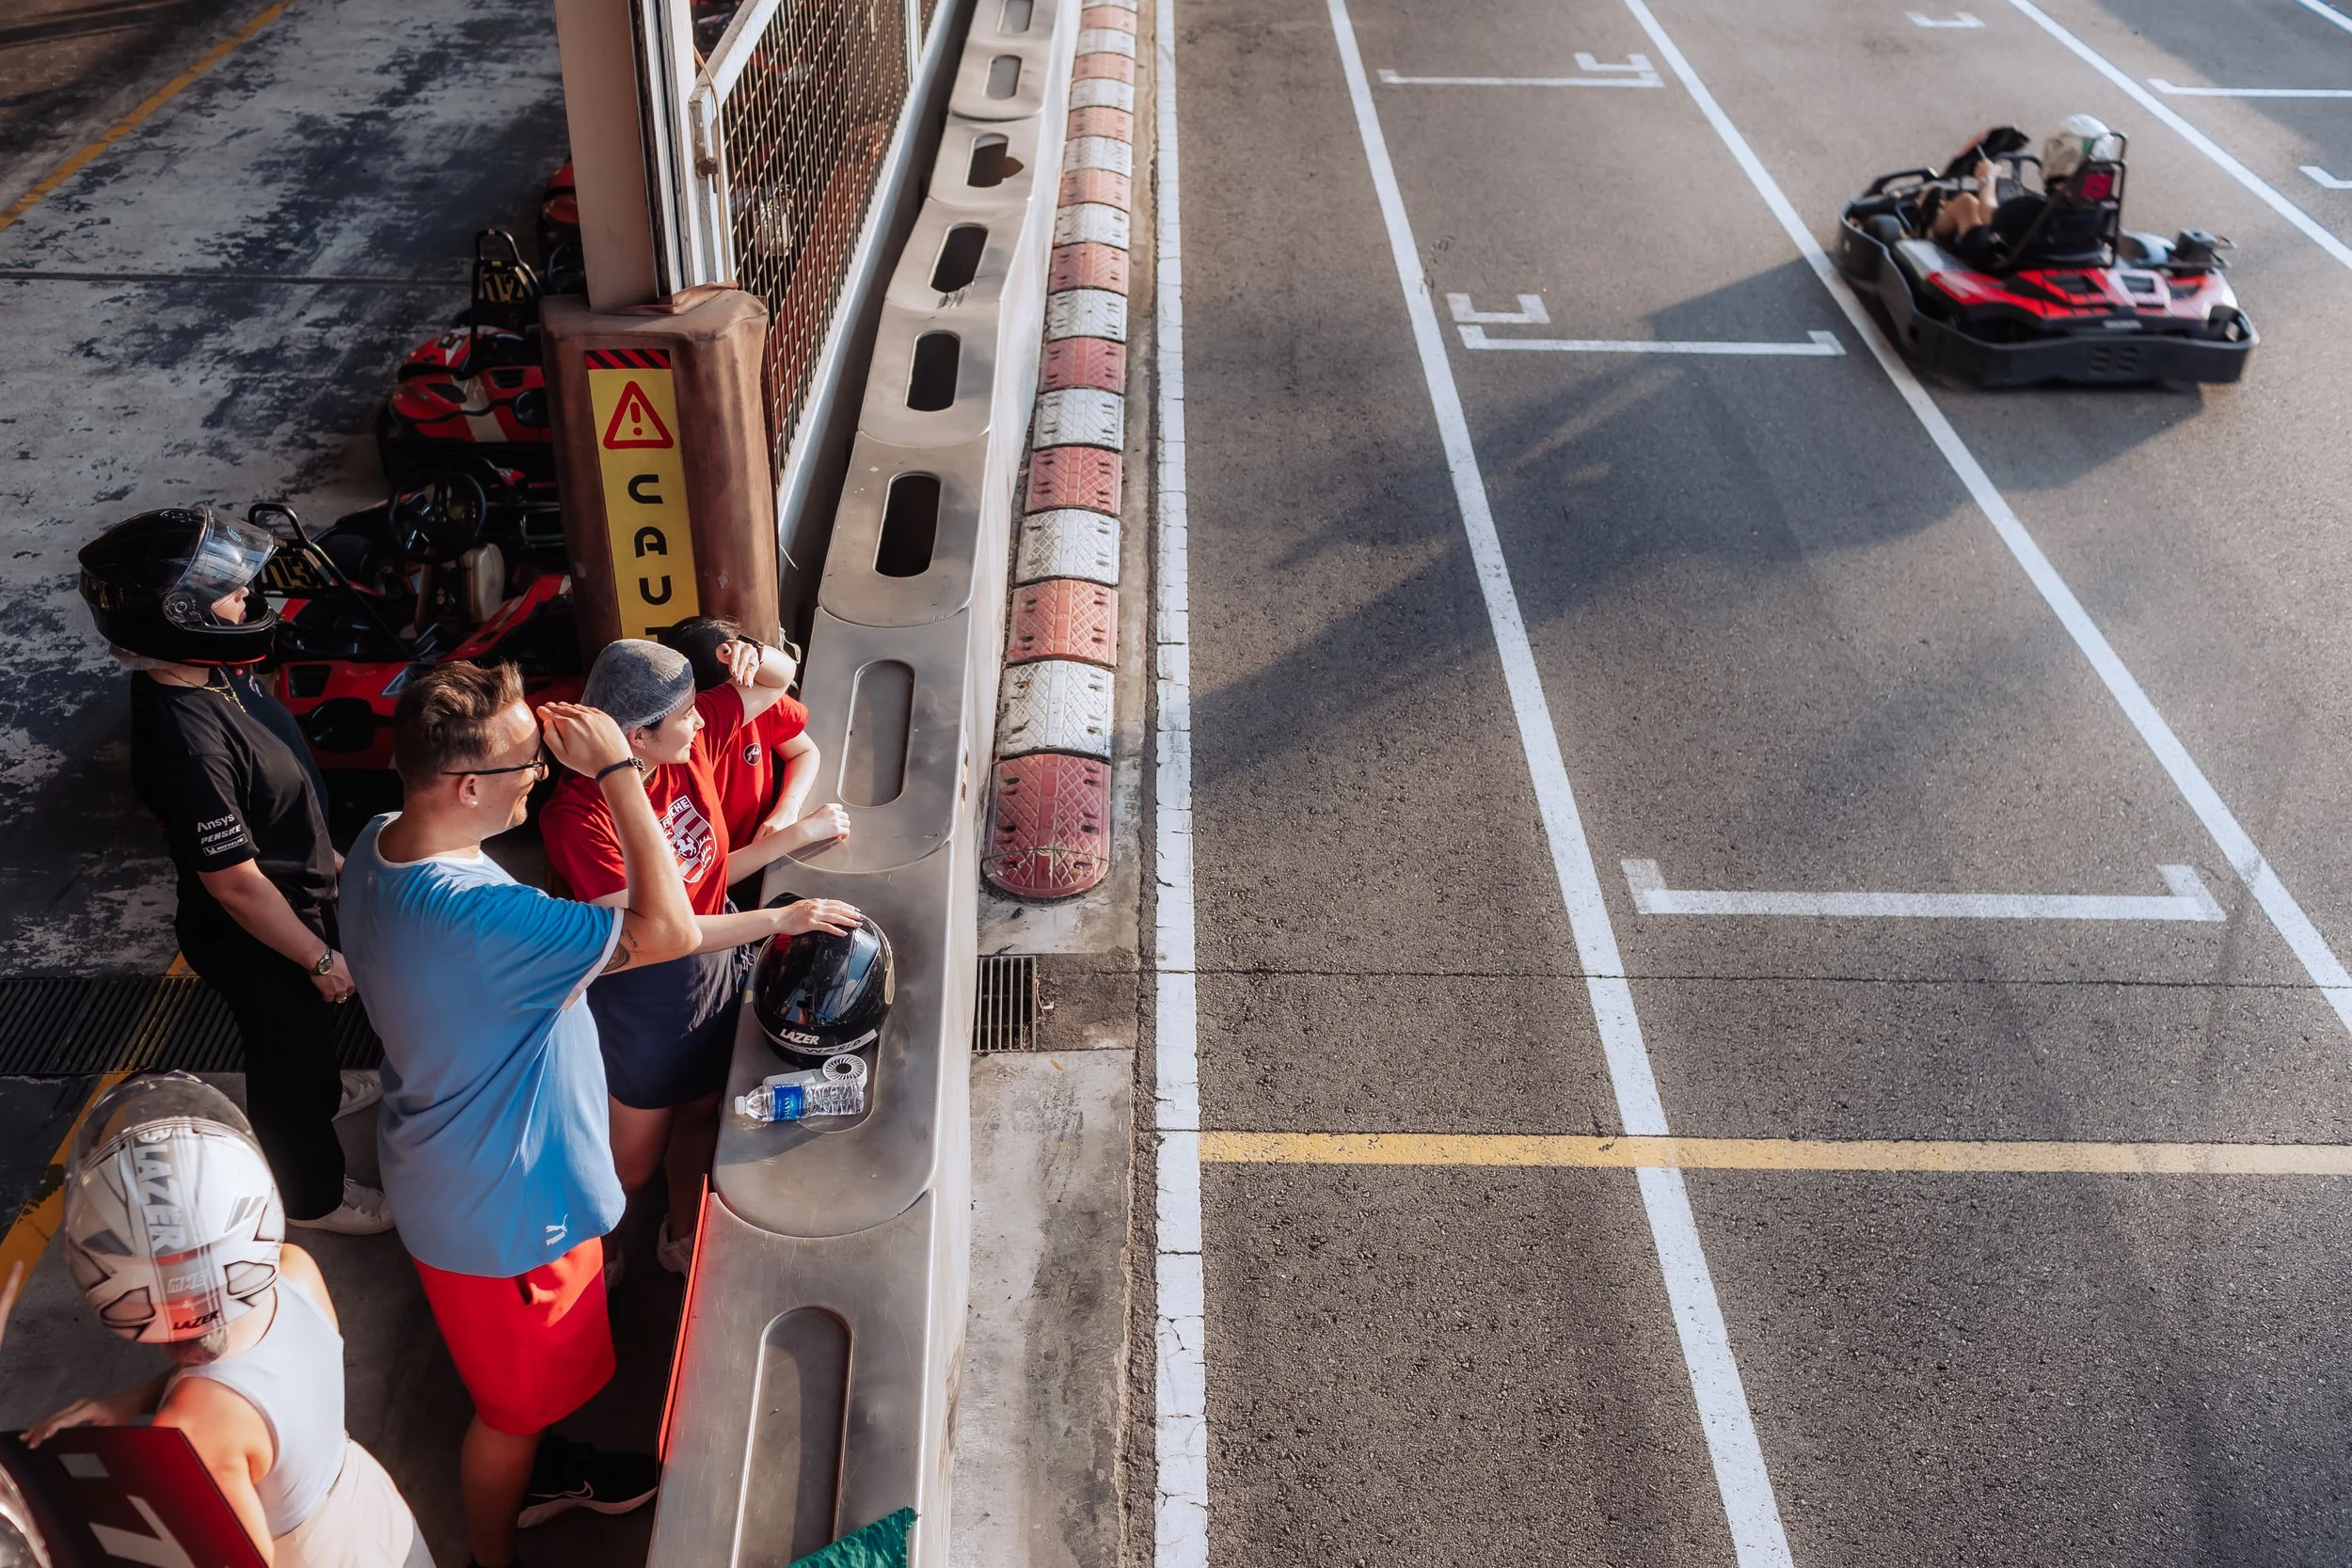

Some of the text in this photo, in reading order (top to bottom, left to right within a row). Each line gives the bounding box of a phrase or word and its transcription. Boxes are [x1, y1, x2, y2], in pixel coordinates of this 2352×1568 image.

[483, 272, 525, 303] 12
[197, 814, 235, 833] Ansys
[200, 824, 242, 845] PENSKE
[780, 1028, 820, 1046] LAZER
[133, 1143, 187, 1255] LAZER
[172, 1309, 220, 1331] LAZER
